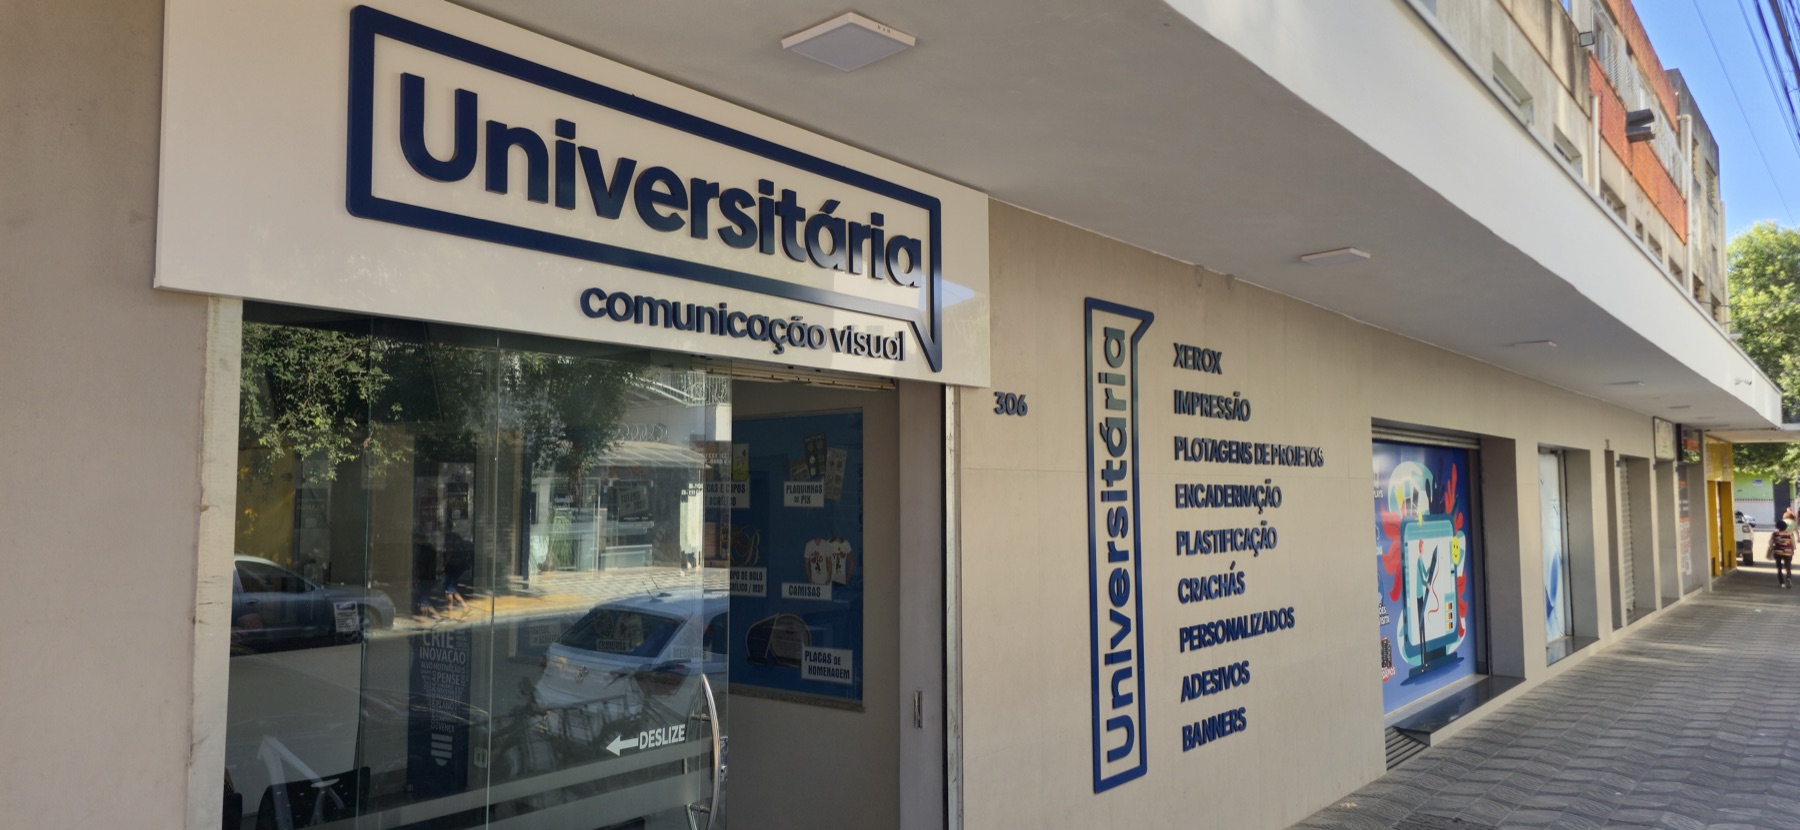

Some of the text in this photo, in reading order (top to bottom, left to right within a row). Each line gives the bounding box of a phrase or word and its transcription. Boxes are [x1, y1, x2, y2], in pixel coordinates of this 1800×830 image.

[400, 72, 922, 288] Universitária
[580, 287, 906, 362] comunicação visual
[1173, 342, 1223, 375] XEROX
[994, 391, 1028, 417] 306
[1173, 390, 1251, 421] IMPRESSÃO
[1174, 436, 1325, 467] PLOTAGENS DE PROJETOS
[786, 484, 823, 494] PLAQUINHAS
[801, 495, 811, 504] PIX
[1175, 479, 1282, 514] ENCADERNAÇÃO
[1099, 326, 1135, 763] Universitária
[1176, 520, 1278, 557] PLASTIFICAÇÃO
[749, 571, 763, 581] BOLO
[788, 585, 821, 597] CAMISAS
[1178, 561, 1246, 604] CRACHÁS
[422, 629, 454, 649] CRIE
[1179, 607, 1295, 652] PERSONALIZADOS
[419, 646, 466, 665] INOVAÇÃO
[804, 650, 841, 665] PLACAS DE
[436, 671, 460, 686] PENSE
[808, 664, 850, 680] HOMENAGEM
[1180, 660, 1251, 703] ADESIVOS
[639, 724, 686, 750] DESLIZE
[1182, 707, 1247, 752] BANNERS
